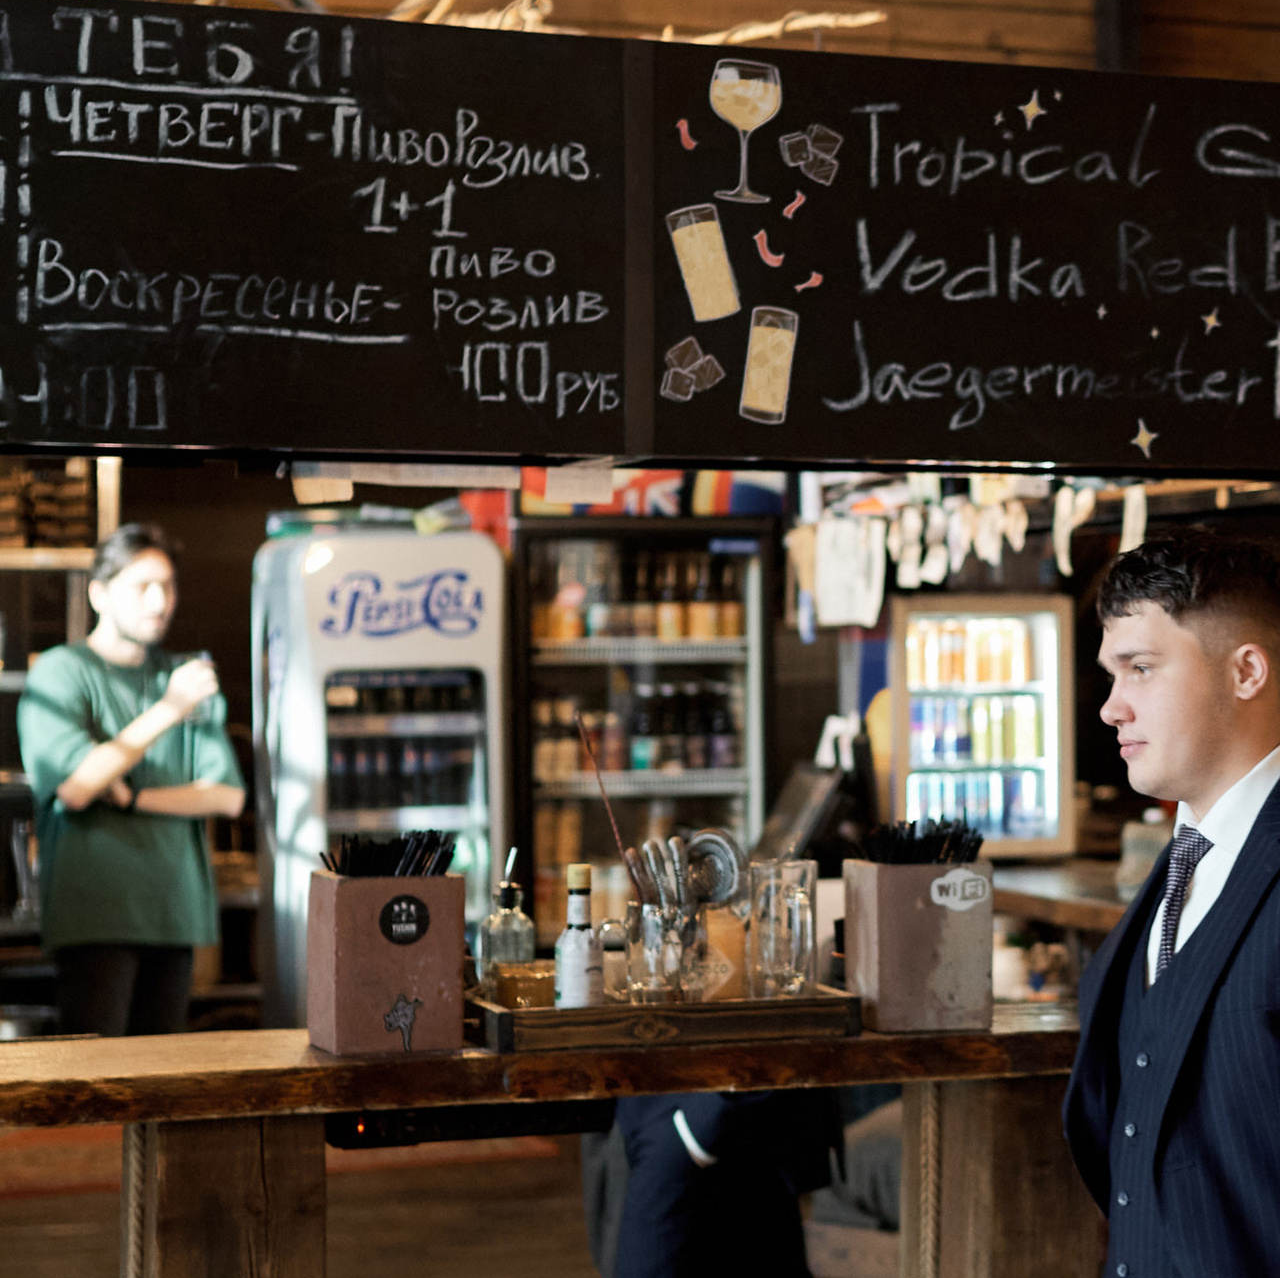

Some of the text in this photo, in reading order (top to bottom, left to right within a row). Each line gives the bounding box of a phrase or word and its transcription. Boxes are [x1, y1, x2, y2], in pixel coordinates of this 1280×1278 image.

[851, 103, 1161, 195] Tropical
[353, 177, 467, 236] 1+1
[857, 219, 1085, 301] Vodka
[1118, 222, 1238, 299] Red
[822, 321, 1262, 430] Jaegermeister
